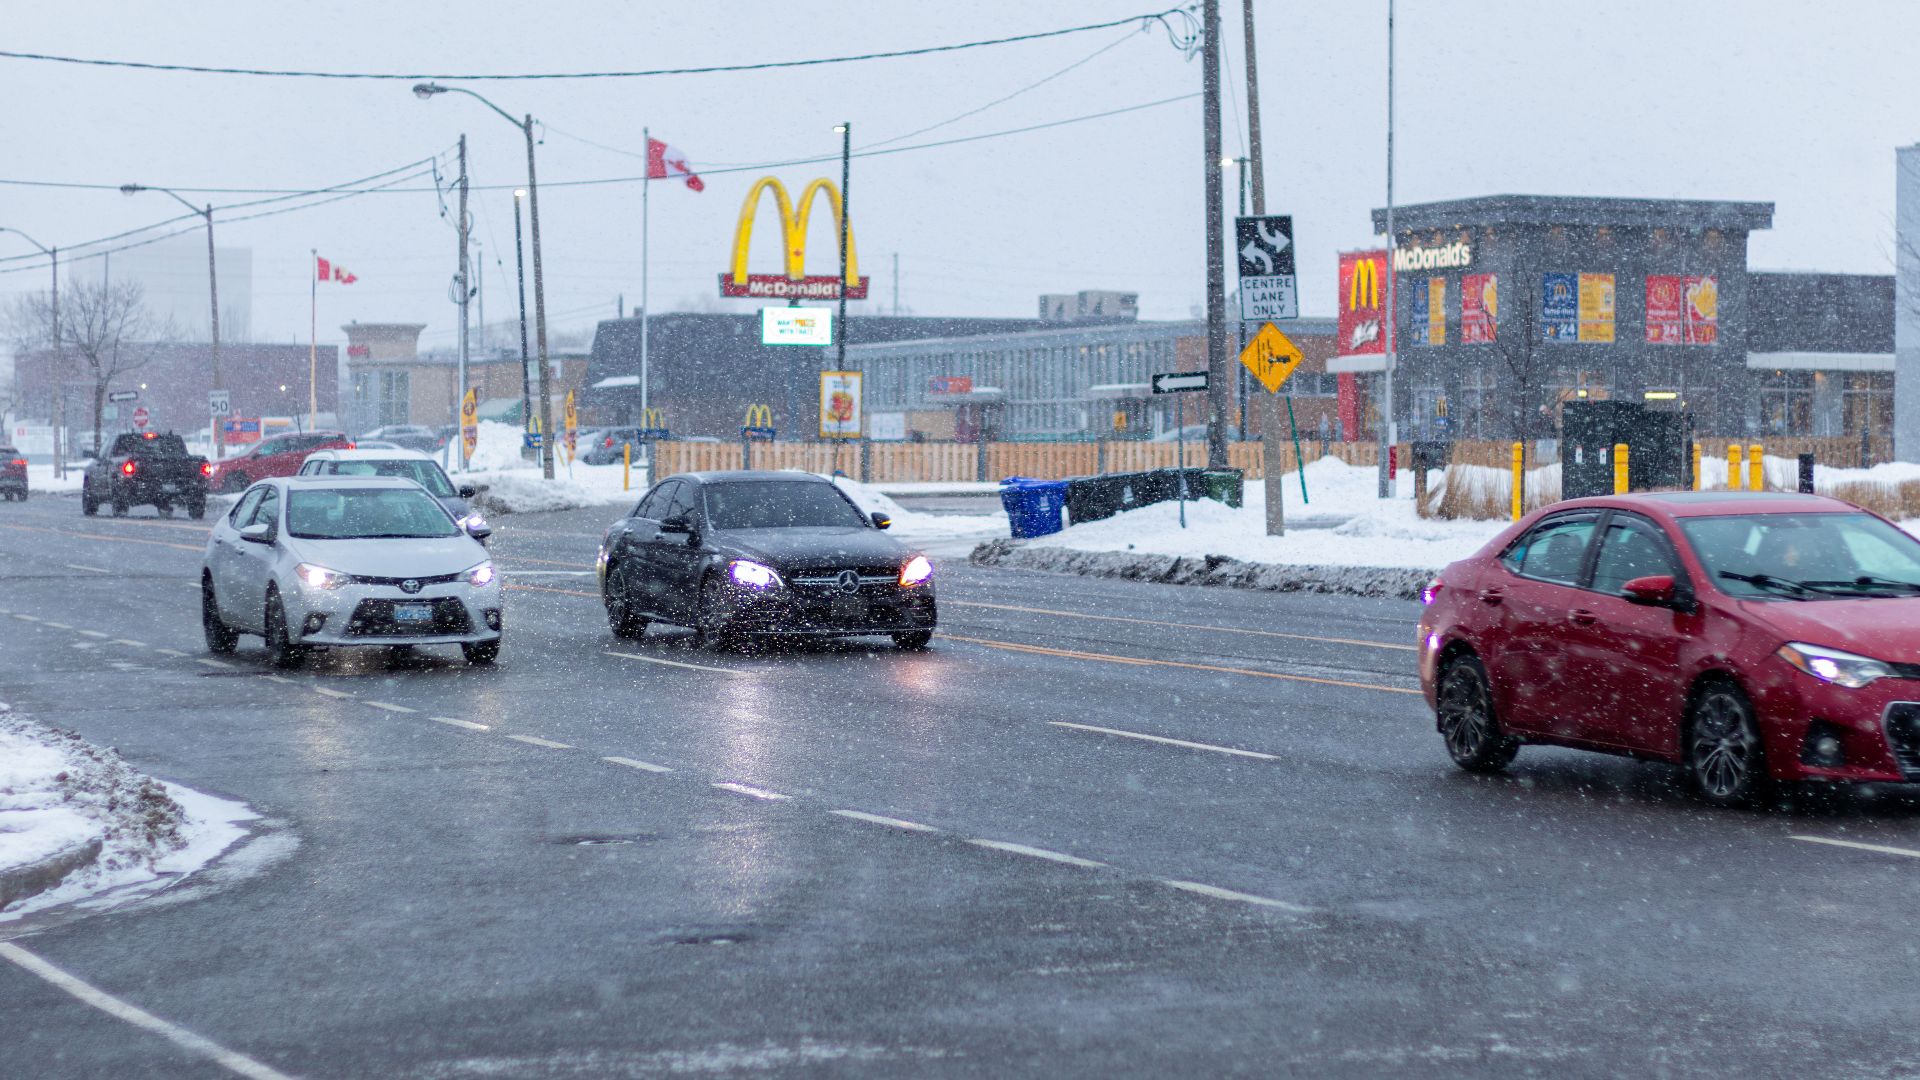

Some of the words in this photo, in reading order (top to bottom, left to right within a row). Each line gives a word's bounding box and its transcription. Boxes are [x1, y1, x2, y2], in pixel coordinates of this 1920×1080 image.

[1394, 242, 1470, 272] McDonald's
[1245, 278, 1291, 289] CENTRE
[1253, 291, 1284, 302] LANE
[1254, 304, 1285, 315] ONLY
[211, 400, 228, 413] 50
